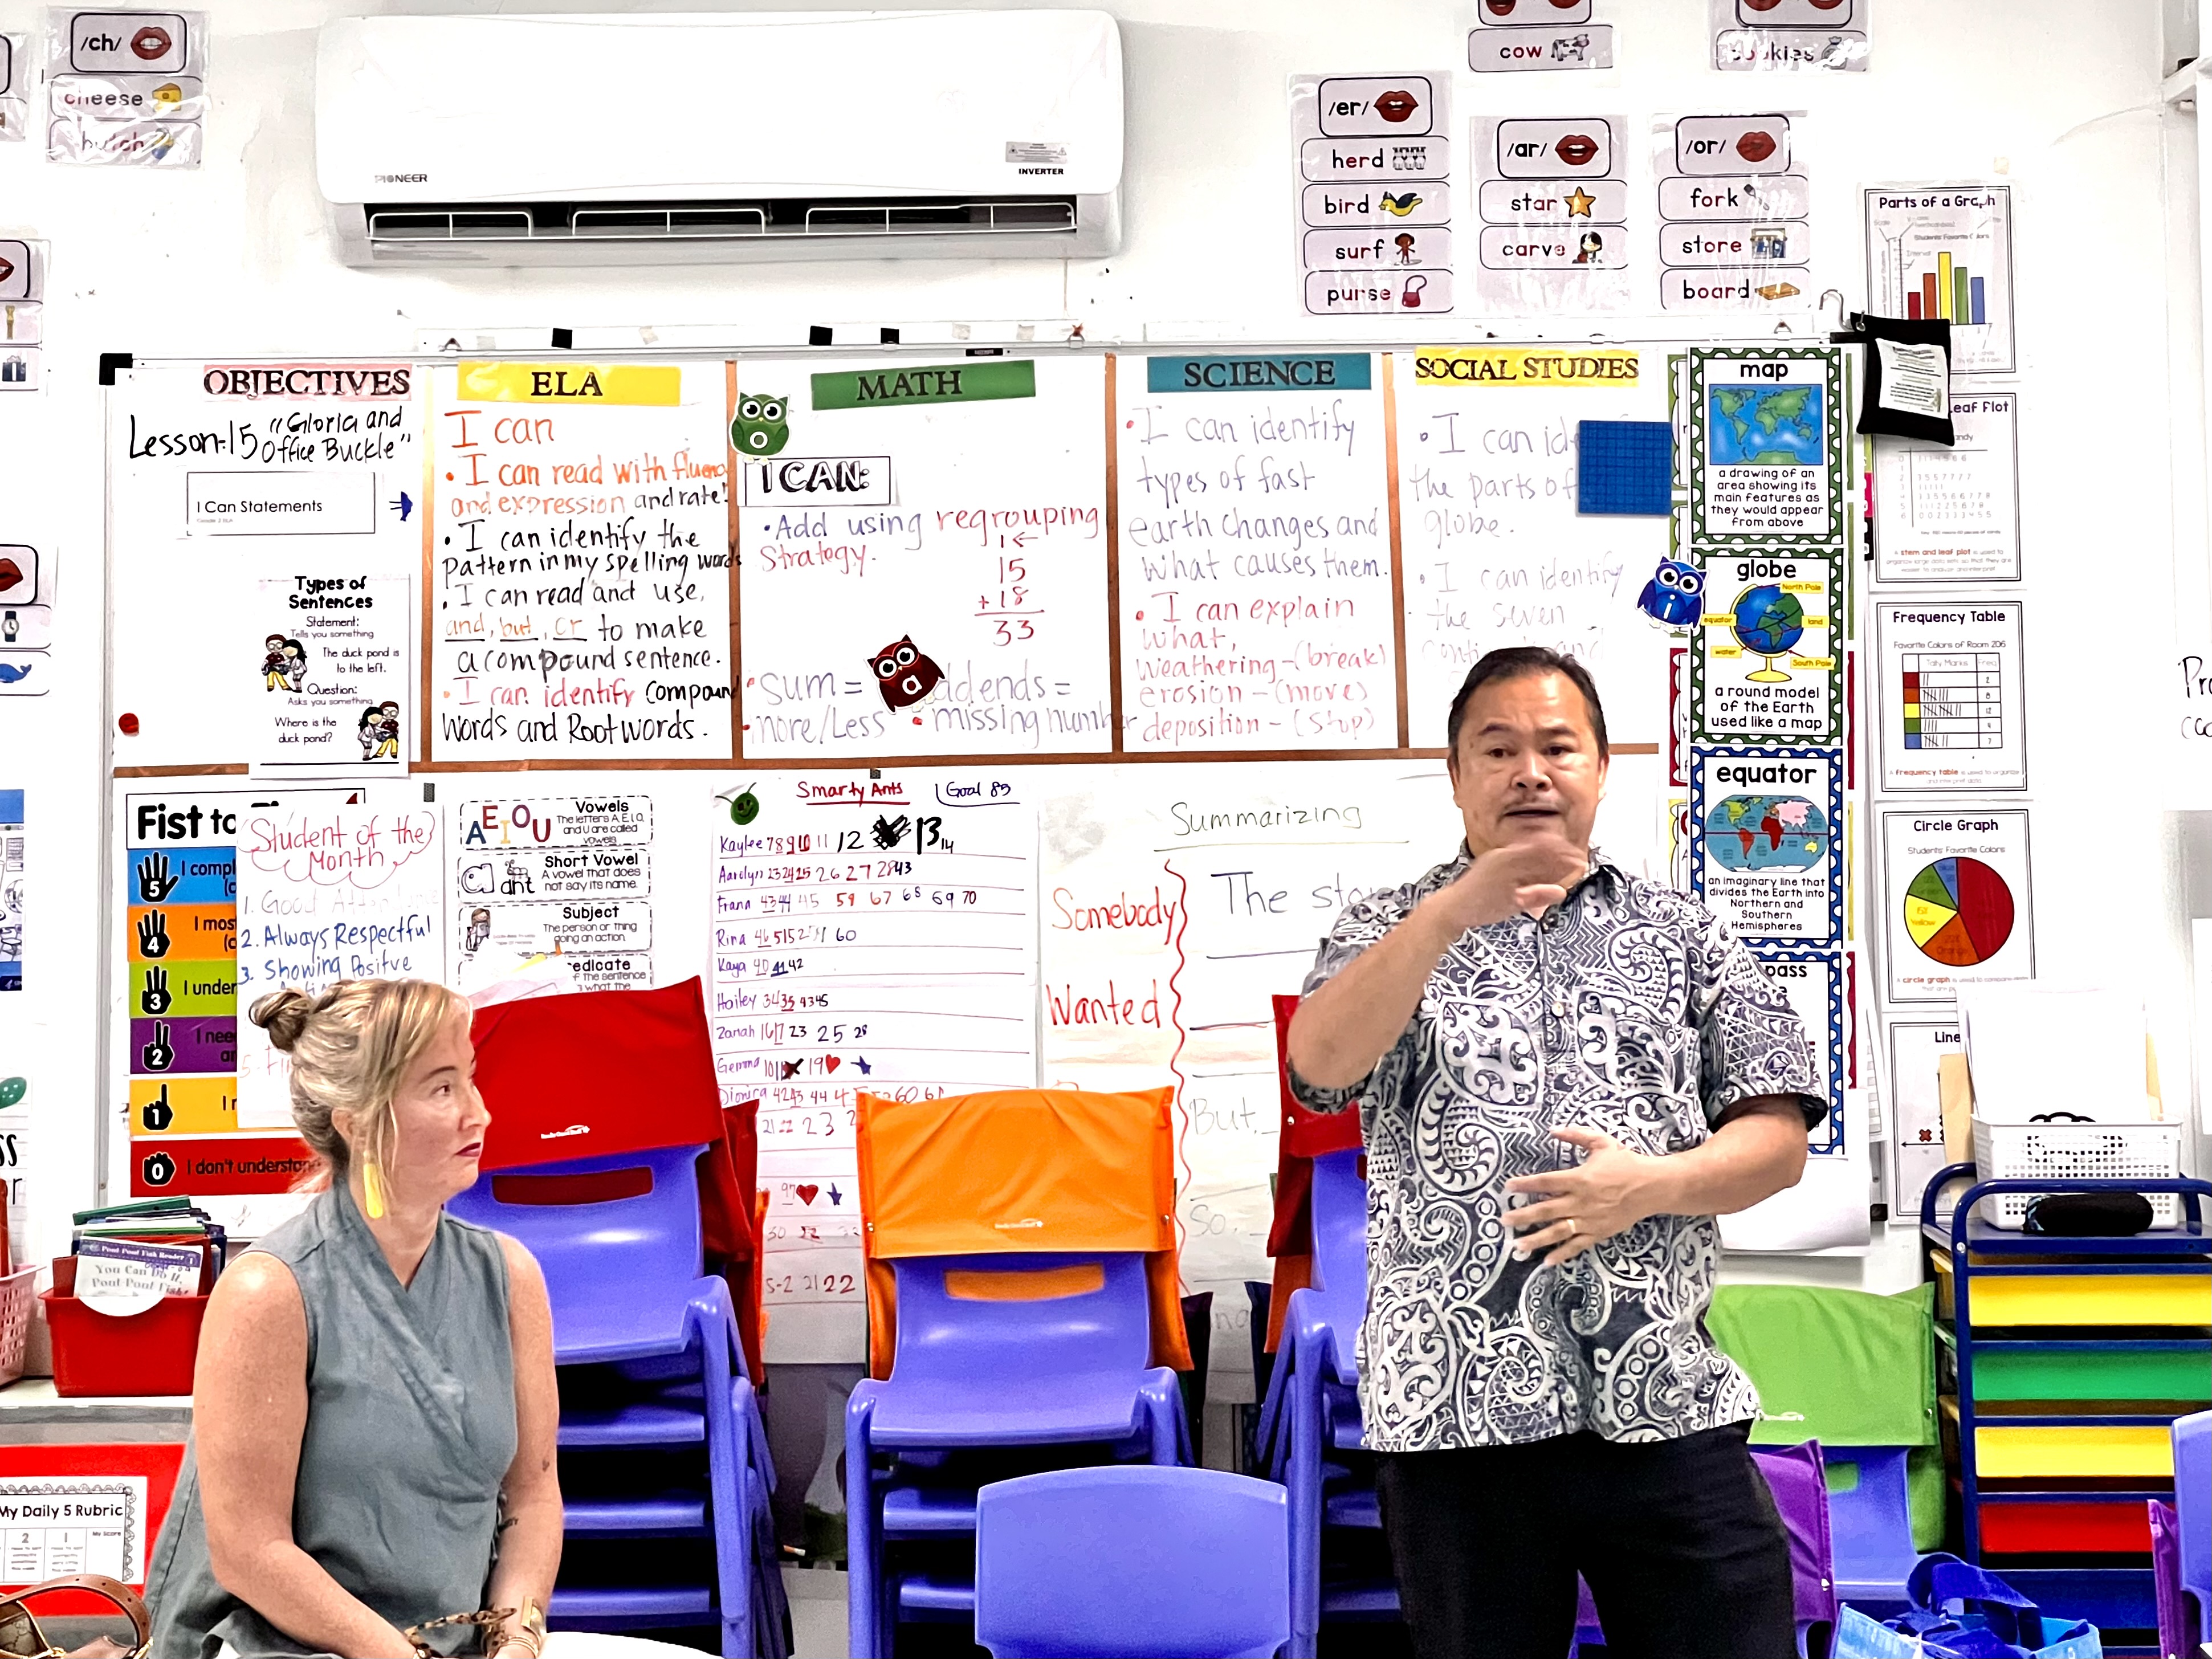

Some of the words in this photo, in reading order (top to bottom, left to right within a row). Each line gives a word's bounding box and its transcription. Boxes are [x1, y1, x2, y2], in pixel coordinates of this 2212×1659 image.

[80, 34, 121, 51] /ch/
[1500, 46, 1542, 59] cow
[1329, 101, 1369, 116] /er/
[1507, 143, 1547, 157] /ar/
[1686, 140, 1726, 154] /or/
[1333, 148, 1383, 168] herd
[375, 174, 427, 182] PIONEER
[1325, 194, 1368, 214] bird
[1512, 193, 1557, 211] star
[1690, 187, 1738, 207] fork
[1880, 197, 1917, 209] Parts
[1922, 196, 1937, 207] of
[1336, 239, 1384, 259] surf
[1502, 245, 1565, 256] carve
[1683, 235, 1741, 254] store
[1684, 279, 1749, 299] board
[1328, 289, 1390, 306] purse
[1185, 361, 1335, 388] SCIENCE
[1416, 358, 1517, 380] SOCIAL
[1523, 357, 1639, 380] STUDIES
[1741, 364, 1788, 381] map
[204, 369, 410, 400] OBJECTIVES
[531, 372, 602, 396] ELA
[857, 370, 962, 401] MATH
[366, 406, 401, 428] and
[1132, 405, 1169, 445] I
[1186, 418, 1238, 443] can
[1250, 399, 1354, 456] identify
[262, 438, 313, 463] Office
[458, 454, 488, 486] I
[499, 464, 540, 486] can
[553, 455, 602, 484] read
[614, 454, 659, 484] with
[762, 462, 772, 493] I
[779, 460, 869, 492] CAN:
[1730, 468, 1778, 480] drawing
[1782, 468, 1796, 477] of
[1137, 455, 1207, 508] types
[1220, 454, 1246, 491] of
[1258, 456, 1315, 493] fast
[1749, 481, 1797, 492] showing
[1802, 481, 1816, 490] its
[1714, 493, 1741, 502] main
[1746, 493, 1801, 502] features
[197, 502, 200, 513] I
[205, 501, 235, 513] Can
[241, 500, 322, 512] Statements
[1711, 506, 1738, 516] they
[1743, 506, 1777, 514] would
[1781, 507, 1823, 516] appear
[776, 512, 827, 540] Add
[849, 513, 922, 551] using
[936, 507, 1099, 547] regrouping
[1732, 517, 1763, 526] from
[1768, 517, 1803, 527] above
[1737, 559, 1796, 581] globe
[295, 576, 344, 595] Types
[349, 576, 366, 590] of
[289, 594, 373, 609] Sentences
[306, 616, 359, 627] Statement:
[1893, 612, 1965, 625] Frequency
[1970, 611, 2005, 622] Table
[307, 683, 357, 695] Question:
[1716, 687, 1723, 696] a
[1728, 686, 1770, 697] round
[1775, 687, 1819, 698] model
[1721, 700, 1738, 711] of
[1744, 701, 1768, 712] the
[1773, 702, 1814, 713] Earth
[1712, 716, 1746, 727] used
[1751, 716, 1773, 727] like
[1791, 719, 1822, 731] map
[1717, 764, 1817, 787] equator
[797, 781, 864, 806] Smarty
[871, 784, 902, 796] Ants
[576, 800, 629, 813] Vowels
[138, 804, 203, 839] Fist
[1171, 802, 1361, 835] Summarizing
[1914, 820, 1952, 831] Circle
[1957, 819, 1998, 833] Graph
[251, 817, 347, 853] Student
[357, 816, 378, 846] of
[392, 815, 424, 845] the
[309, 847, 384, 871] Month
[545, 855, 588, 867] Short
[593, 853, 638, 866] Vowel
[149, 882, 159, 896] 5
[1724, 877, 1778, 890] imaginary
[1211, 871, 1287, 915] The
[1773, 887, 1802, 897] Earth
[1731, 899, 1781, 907] Northern
[563, 906, 619, 922] Subject
[1052, 887, 1176, 944] Somebody
[1742, 910, 1792, 919] Southern
[1732, 921, 1802, 932] Hemispheres
[148, 938, 158, 952] 4
[264, 925, 328, 963] Always
[335, 915, 430, 955] Respectful
[151, 995, 161, 1010] 3
[1046, 979, 1160, 1028] Wanted
[153, 1050, 162, 1065] 2
[153, 1110, 159, 1124] 1
[152, 1164, 164, 1179] 0
[188, 1159, 191, 1175] I
[195, 1159, 234, 1175] don't
[23, 1505, 59, 1519] Daily
[64, 1505, 71, 1516] 5
[76, 1504, 123, 1516] Rubric
